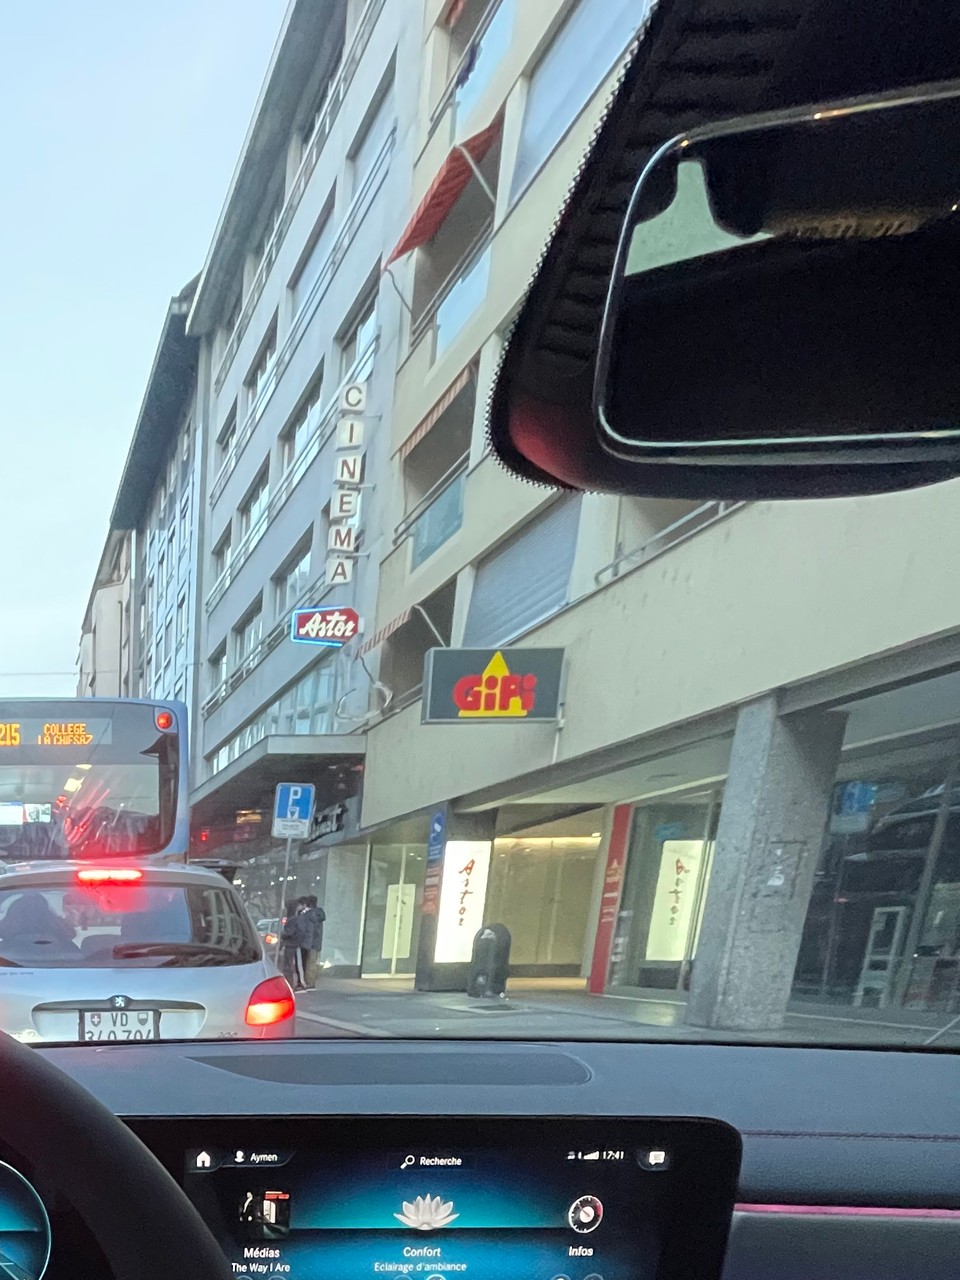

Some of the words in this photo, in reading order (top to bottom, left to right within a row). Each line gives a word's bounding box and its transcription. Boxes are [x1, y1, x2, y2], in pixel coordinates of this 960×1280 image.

[331, 386, 363, 581] CINEMA
[299, 611, 356, 638] Astor
[44, 723, 86, 735] COLLEGE
[111, 1012, 128, 1027] VD
[250, 1153, 278, 1163] Aymen
[419, 1156, 462, 1166] Recherche
[602, 1151, 624, 1160] 17:41
[244, 1247, 280, 1258] Médias
[403, 1247, 441, 1257] Confort
[569, 1246, 593, 1256] Infos
[231, 1262, 247, 1272] The
[249, 1263, 268, 1274] Way
[275, 1263, 291, 1272] Are
[374, 1262, 414, 1273] Eclairage
[416, 1262, 467, 1271] d'ambiance
